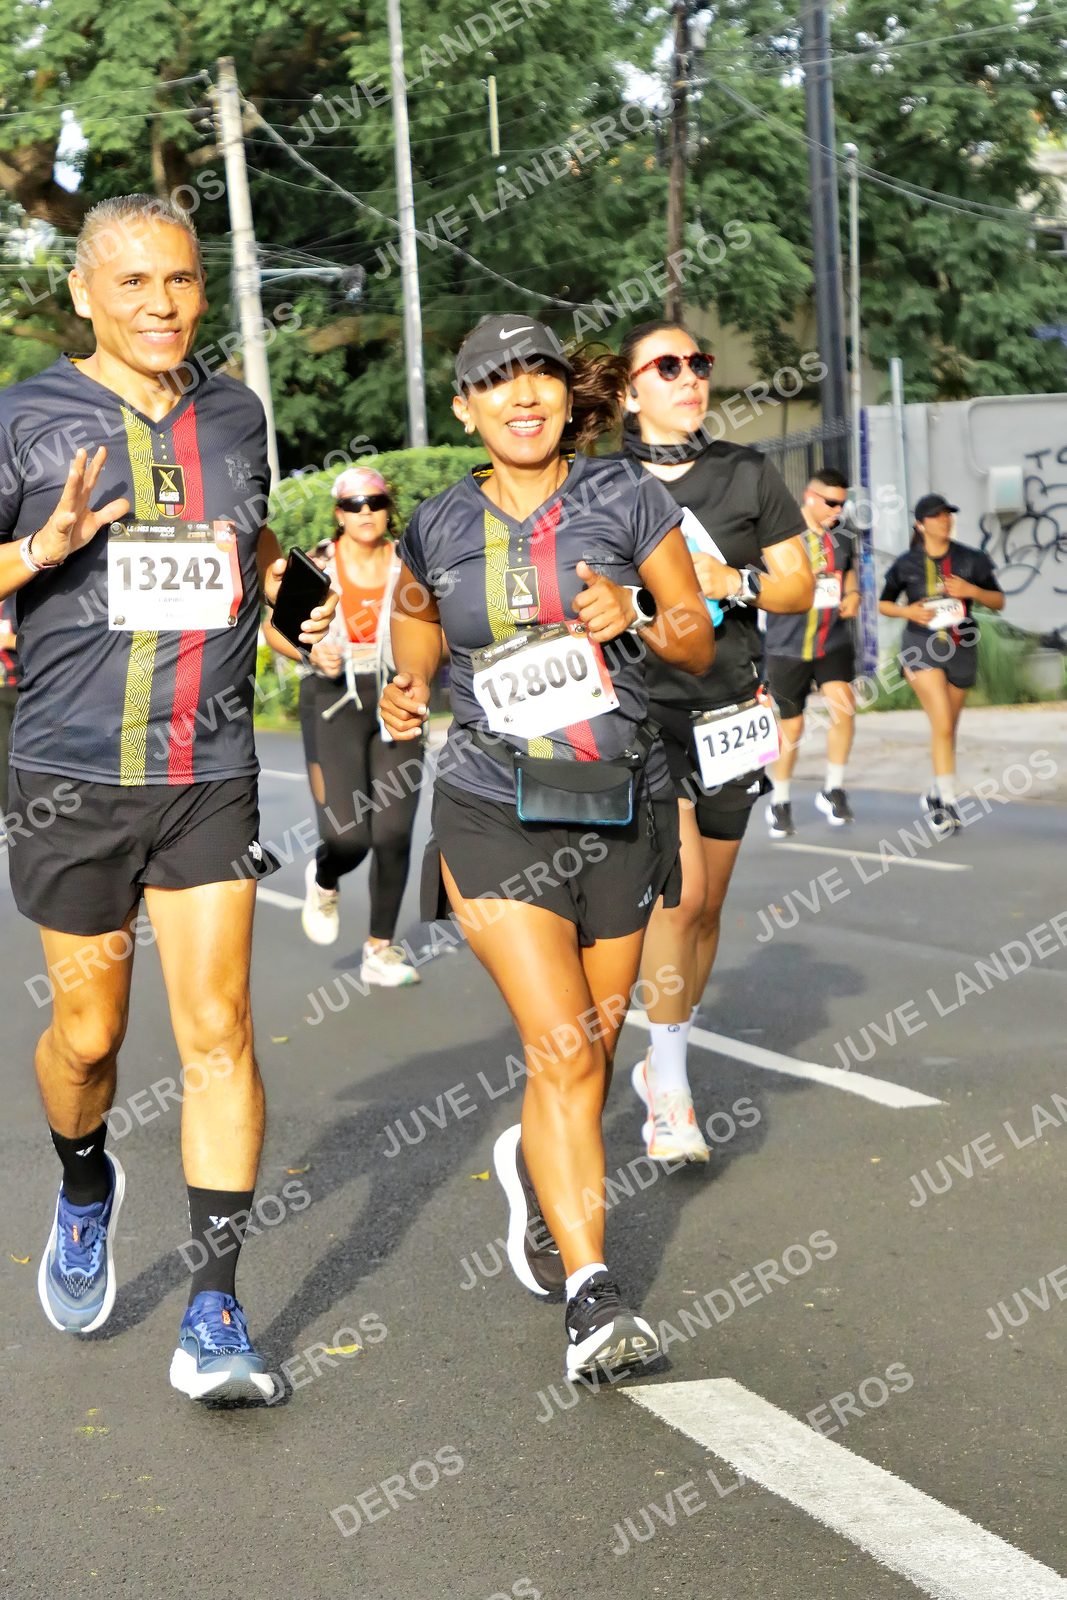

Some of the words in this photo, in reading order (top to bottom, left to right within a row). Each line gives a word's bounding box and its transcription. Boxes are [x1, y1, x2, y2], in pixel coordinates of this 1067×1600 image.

[116, 556, 223, 590] 13242
[481, 649, 588, 709] 12800
[703, 715, 770, 758] 13249
